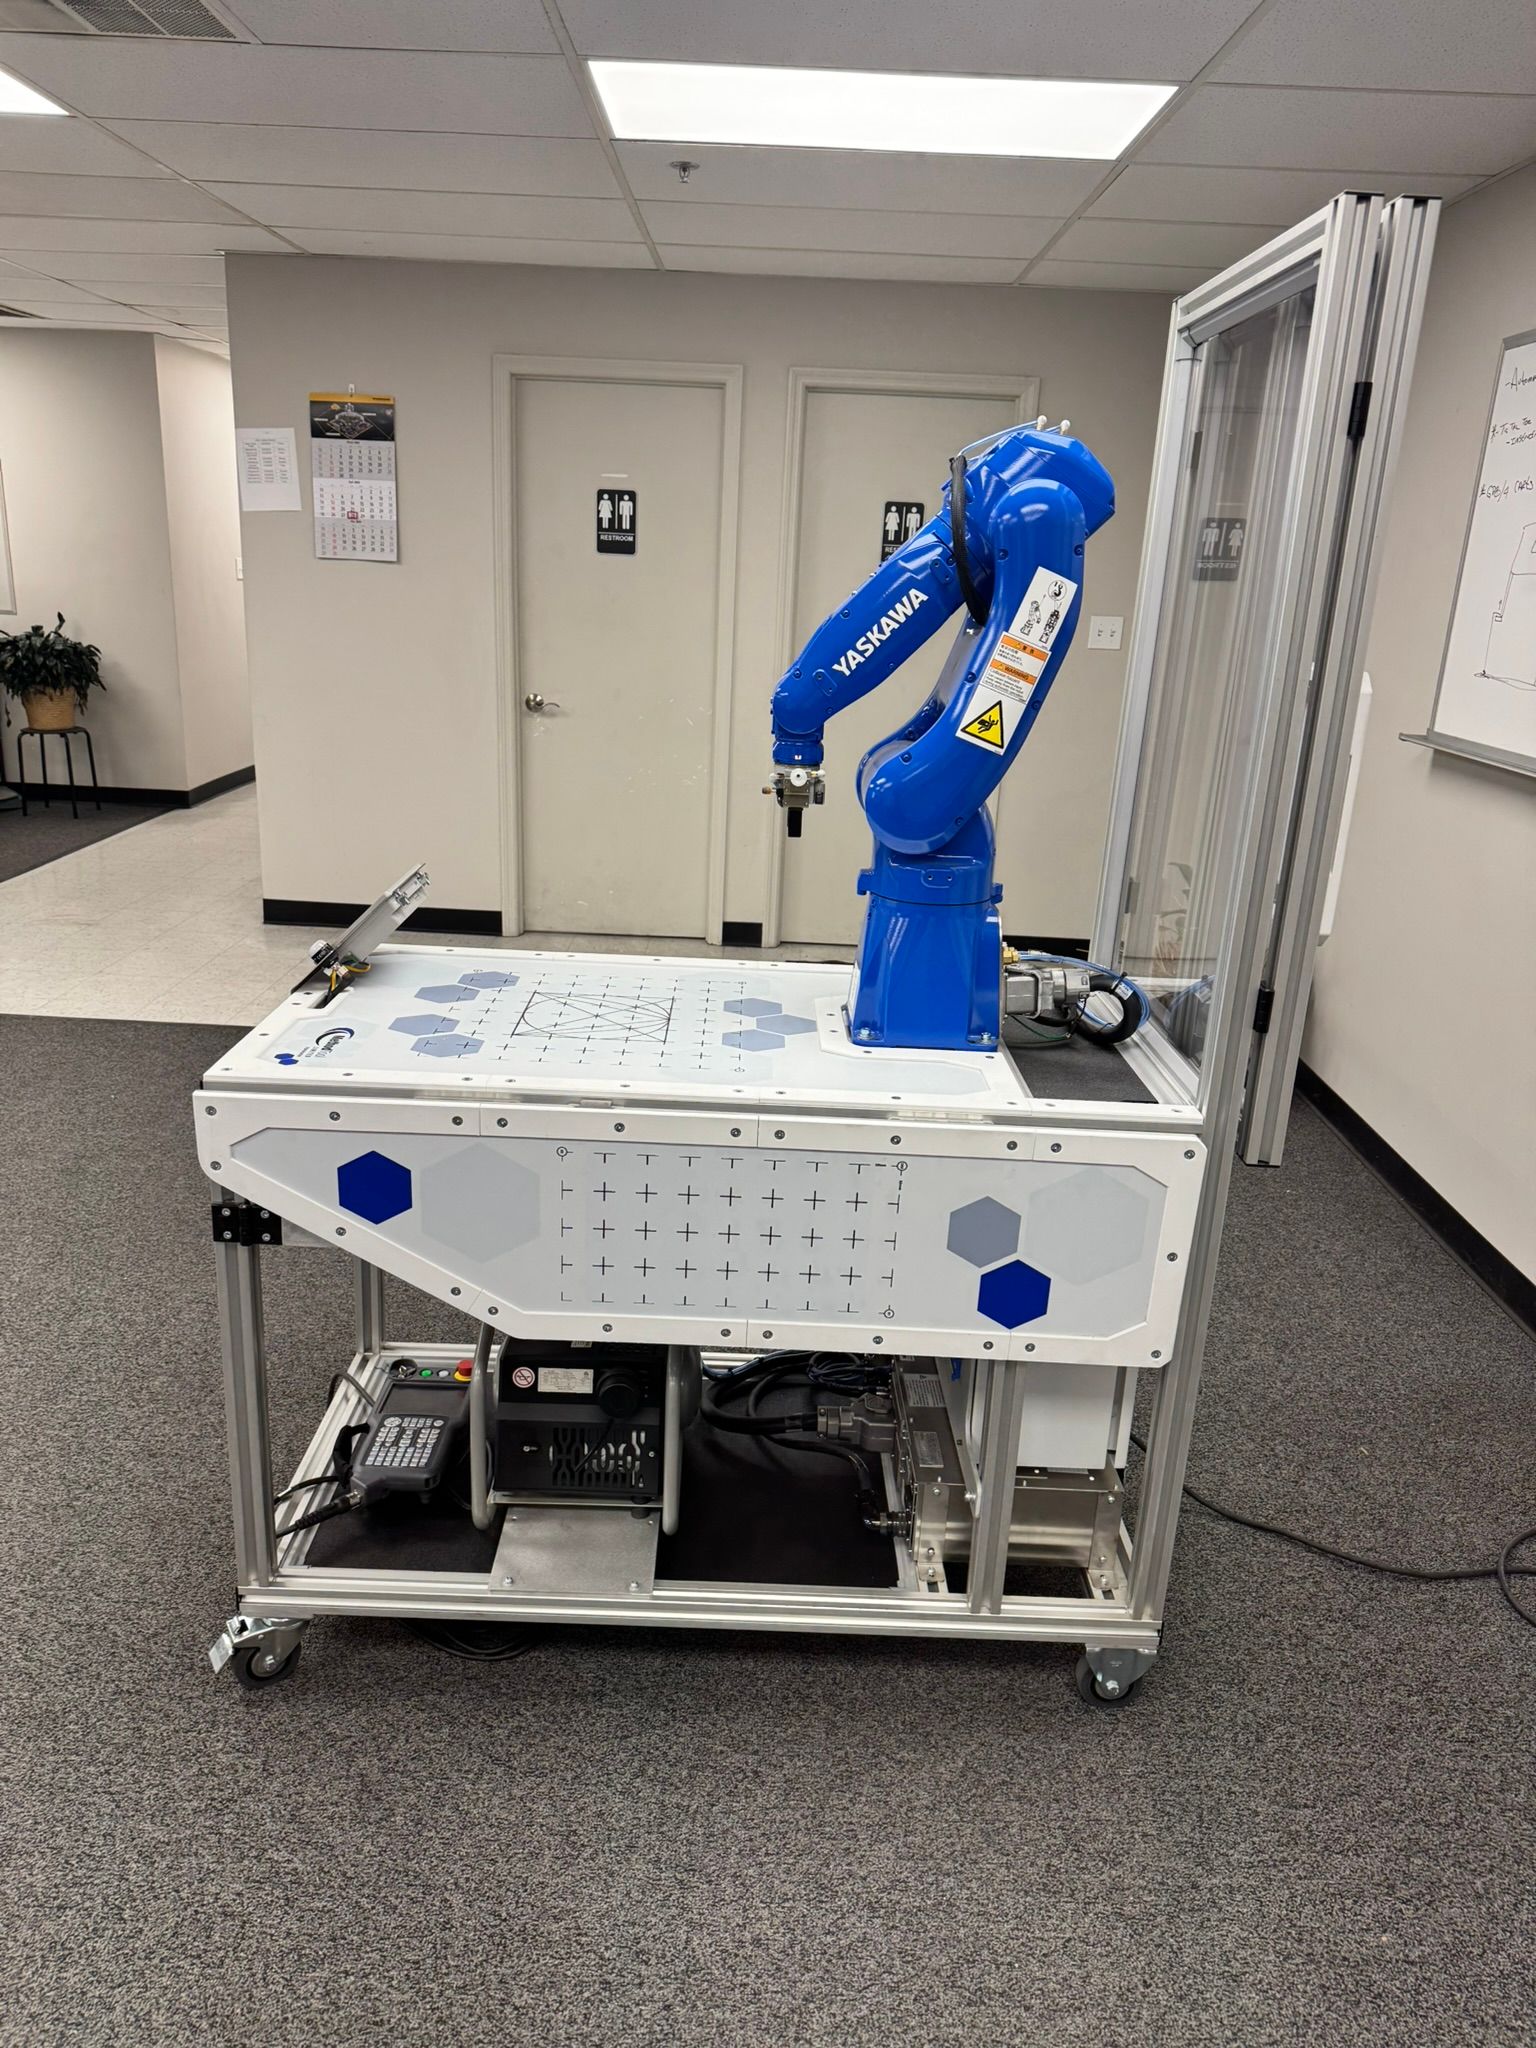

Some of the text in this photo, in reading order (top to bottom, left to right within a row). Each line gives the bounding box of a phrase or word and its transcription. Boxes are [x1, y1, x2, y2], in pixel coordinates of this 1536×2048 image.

[600, 534, 634, 542] RESTROOM
[832, 588, 929, 677] YASKAWA
[1004, 665, 1029, 681] WARNING
